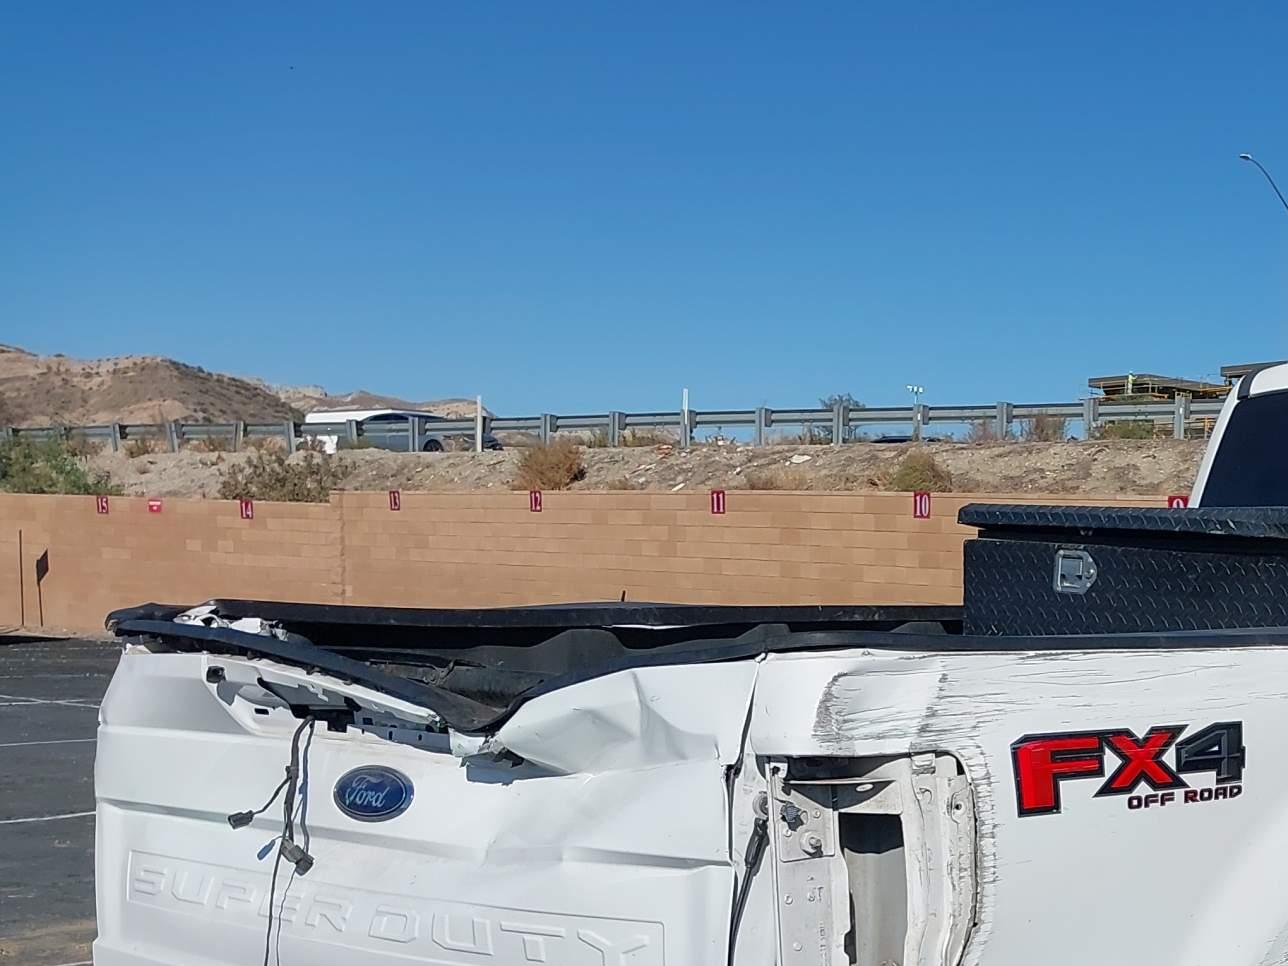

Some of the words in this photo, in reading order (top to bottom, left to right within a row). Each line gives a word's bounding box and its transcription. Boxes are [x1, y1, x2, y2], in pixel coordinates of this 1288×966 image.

[97, 497, 108, 513] 15
[241, 501, 253, 518] 14
[390, 492, 400, 509] 13
[531, 492, 541, 510] 12
[712, 492, 725, 513] 11
[915, 495, 929, 517] 10
[1010, 721, 1246, 818] FX4
[346, 775, 391, 808] Ford
[1127, 792, 1175, 810] OFF
[1184, 784, 1243, 804] ROAD
[132, 867, 354, 933] SUPER
